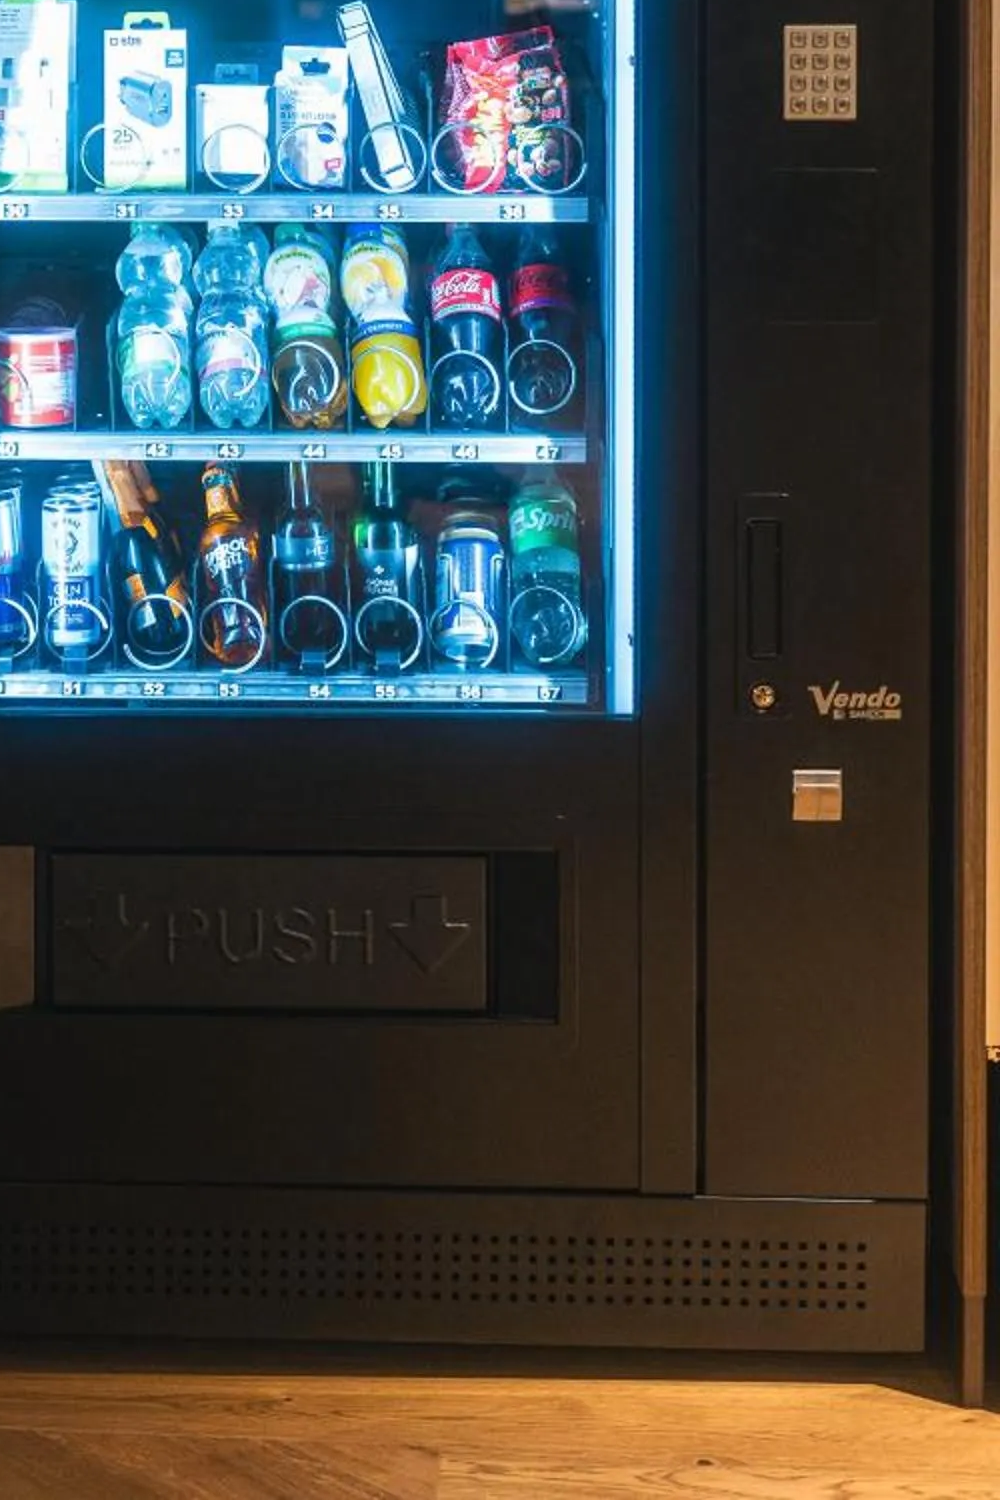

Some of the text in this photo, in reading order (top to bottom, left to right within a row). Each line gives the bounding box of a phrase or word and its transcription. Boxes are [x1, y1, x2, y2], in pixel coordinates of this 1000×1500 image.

[116, 205, 137, 218] 31
[313, 205, 334, 218] 34
[219, 444, 240, 457] 43
[304, 445, 325, 458] 44
[144, 684, 165, 696] 52
[220, 684, 239, 696] 53
[309, 686, 330, 698] 54
[375, 686, 396, 698] 55
[807, 680, 901, 715] Vendo
[167, 907, 374, 965] PUSH
